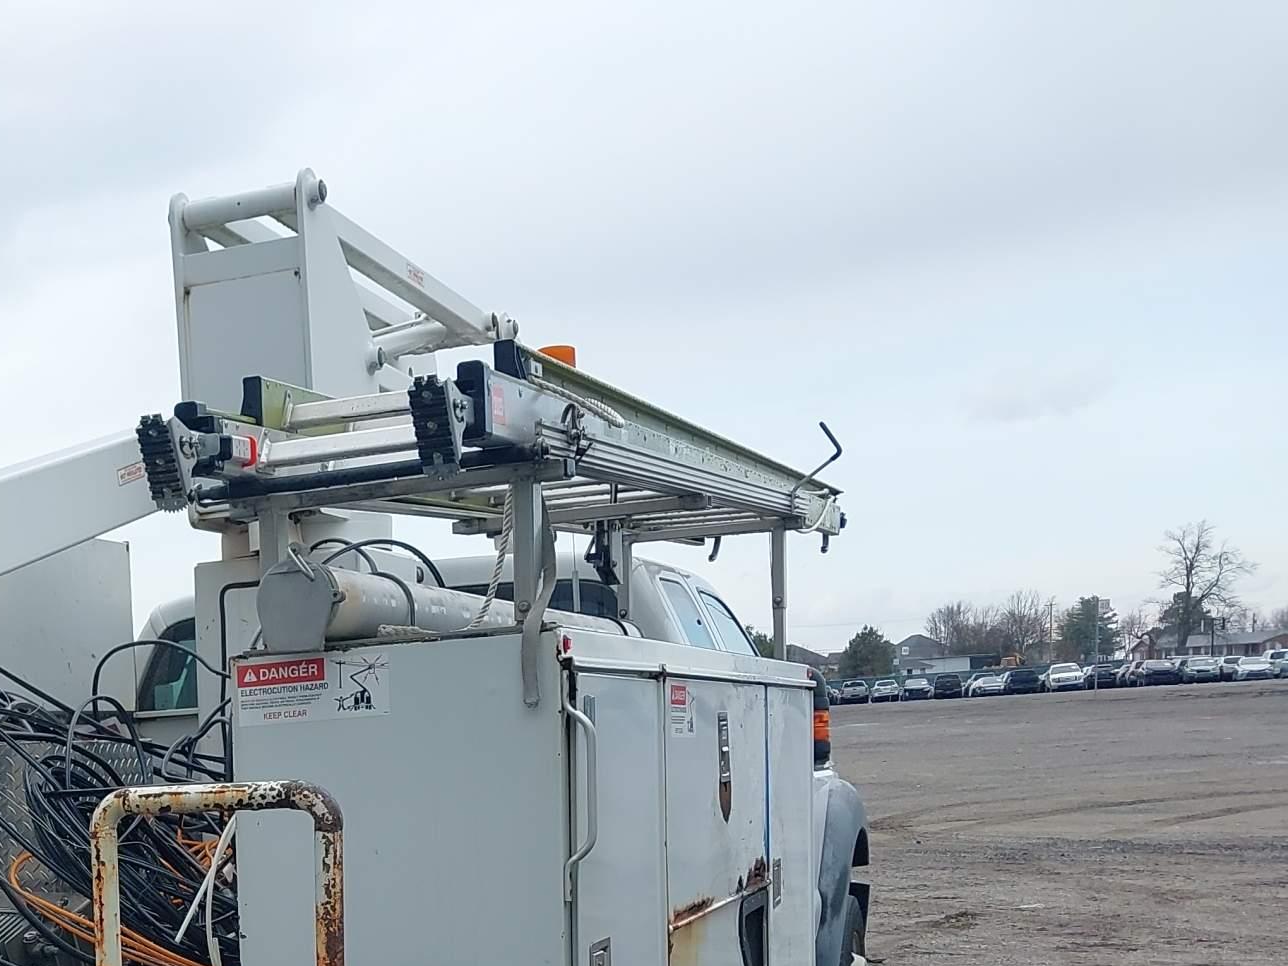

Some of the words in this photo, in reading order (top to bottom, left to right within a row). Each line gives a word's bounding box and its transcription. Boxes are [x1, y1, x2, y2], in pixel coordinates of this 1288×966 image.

[259, 663, 318, 681] DANGER
[240, 685, 299, 698] ELECTROCUTION
[299, 682, 329, 692] HAZARD
[263, 711, 282, 721] KEEP
[283, 709, 308, 719] CLEAR
